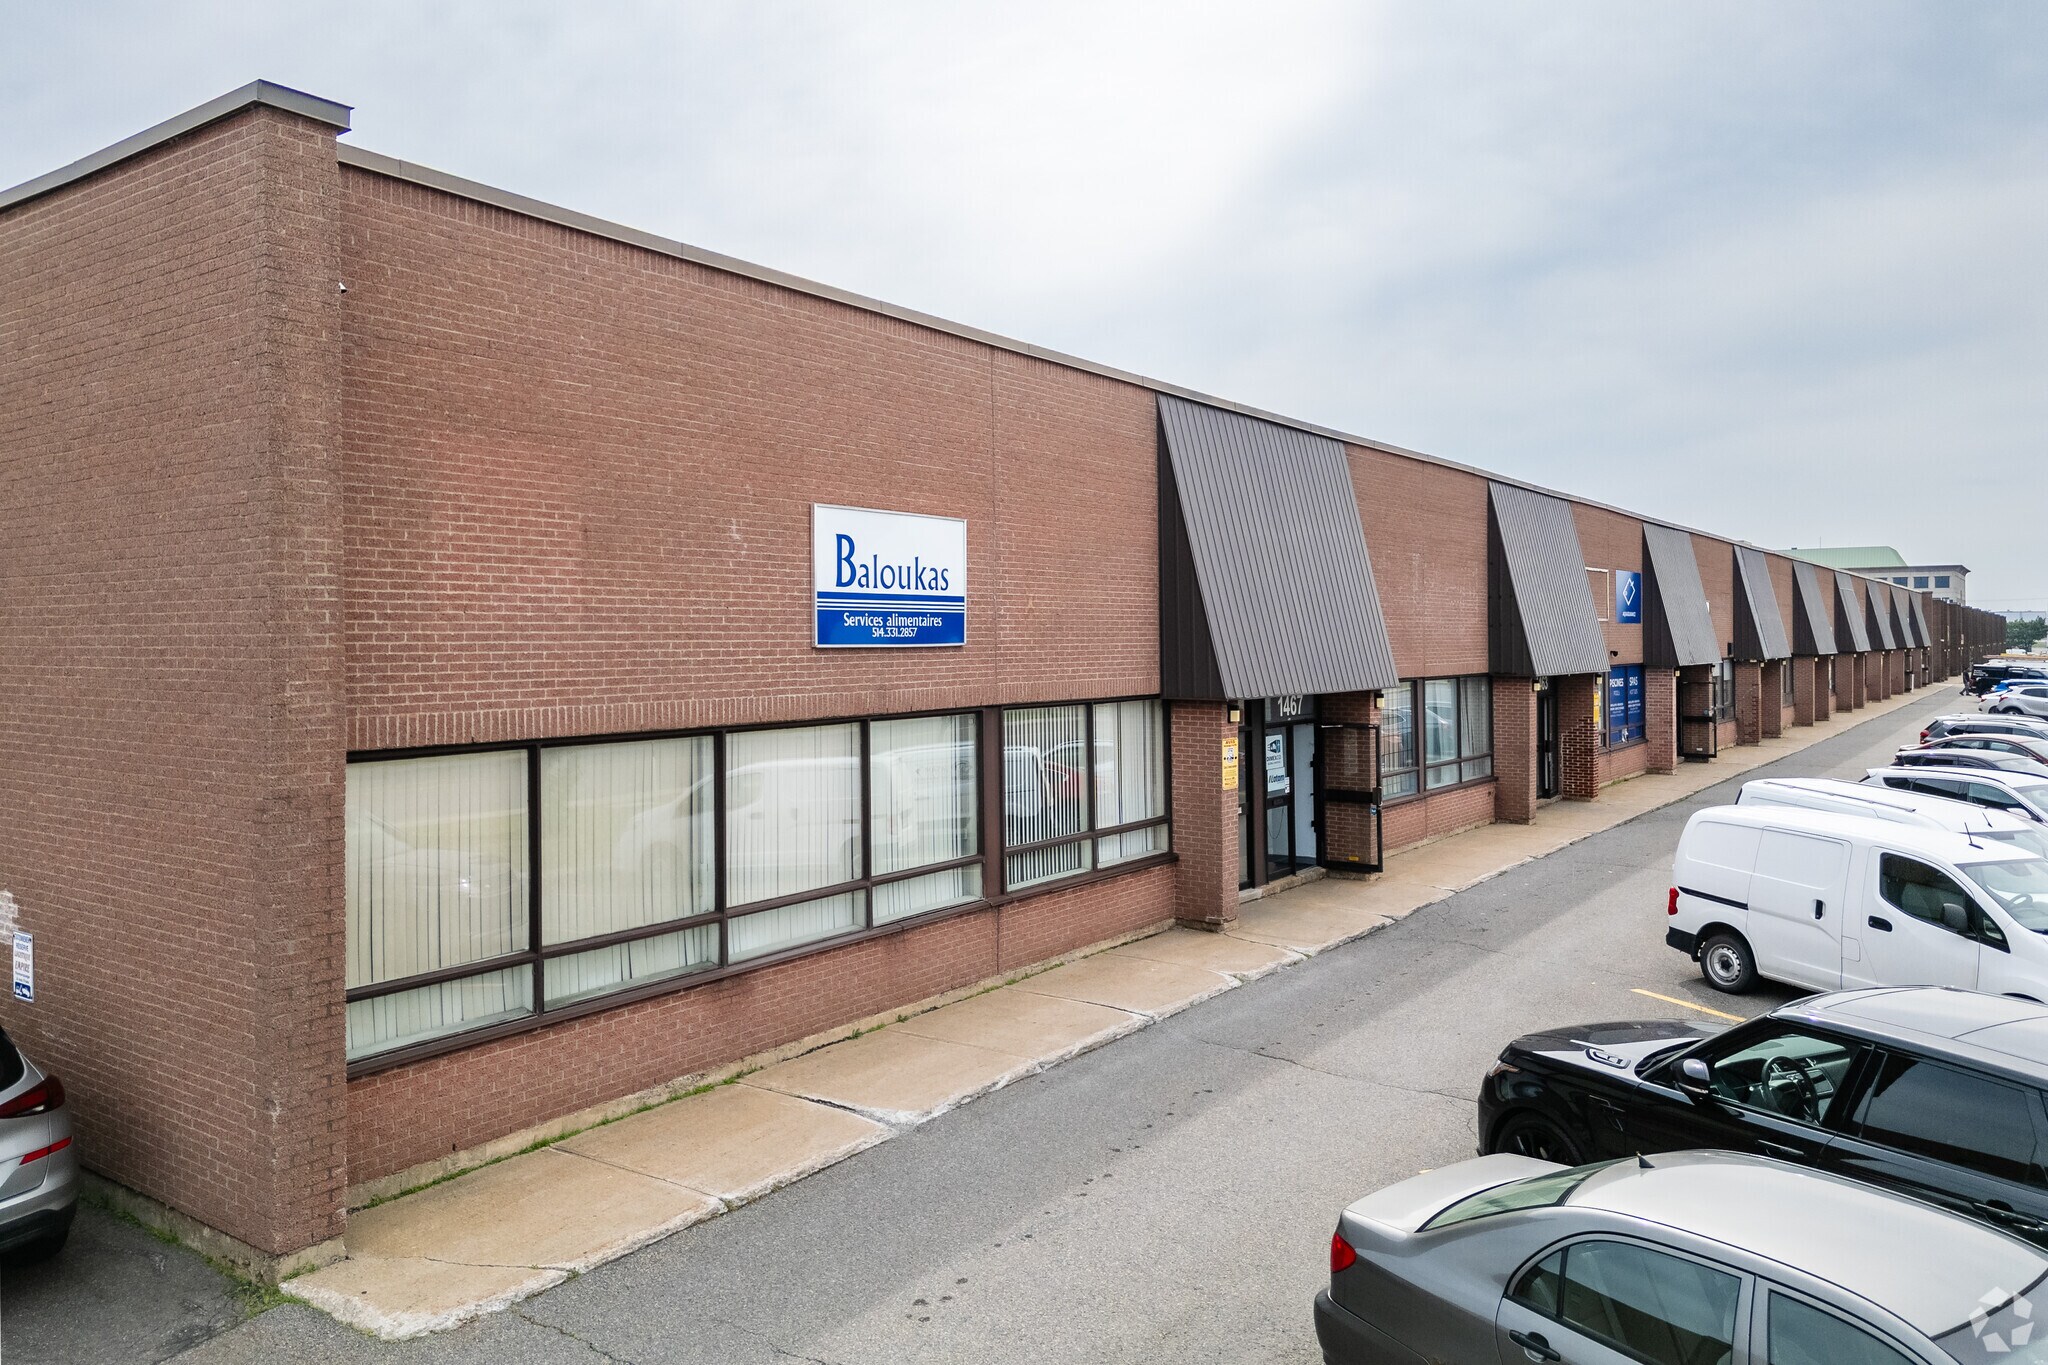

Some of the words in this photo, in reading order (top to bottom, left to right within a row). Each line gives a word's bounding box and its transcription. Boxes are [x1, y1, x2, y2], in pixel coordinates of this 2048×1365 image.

[835, 533, 949, 591] Baloukas
[843, 612, 883, 627] Services
[886, 613, 942, 627] alimentaires
[872, 627, 917, 638] 514.331.2857
[1277, 694, 1303, 717] 1467
